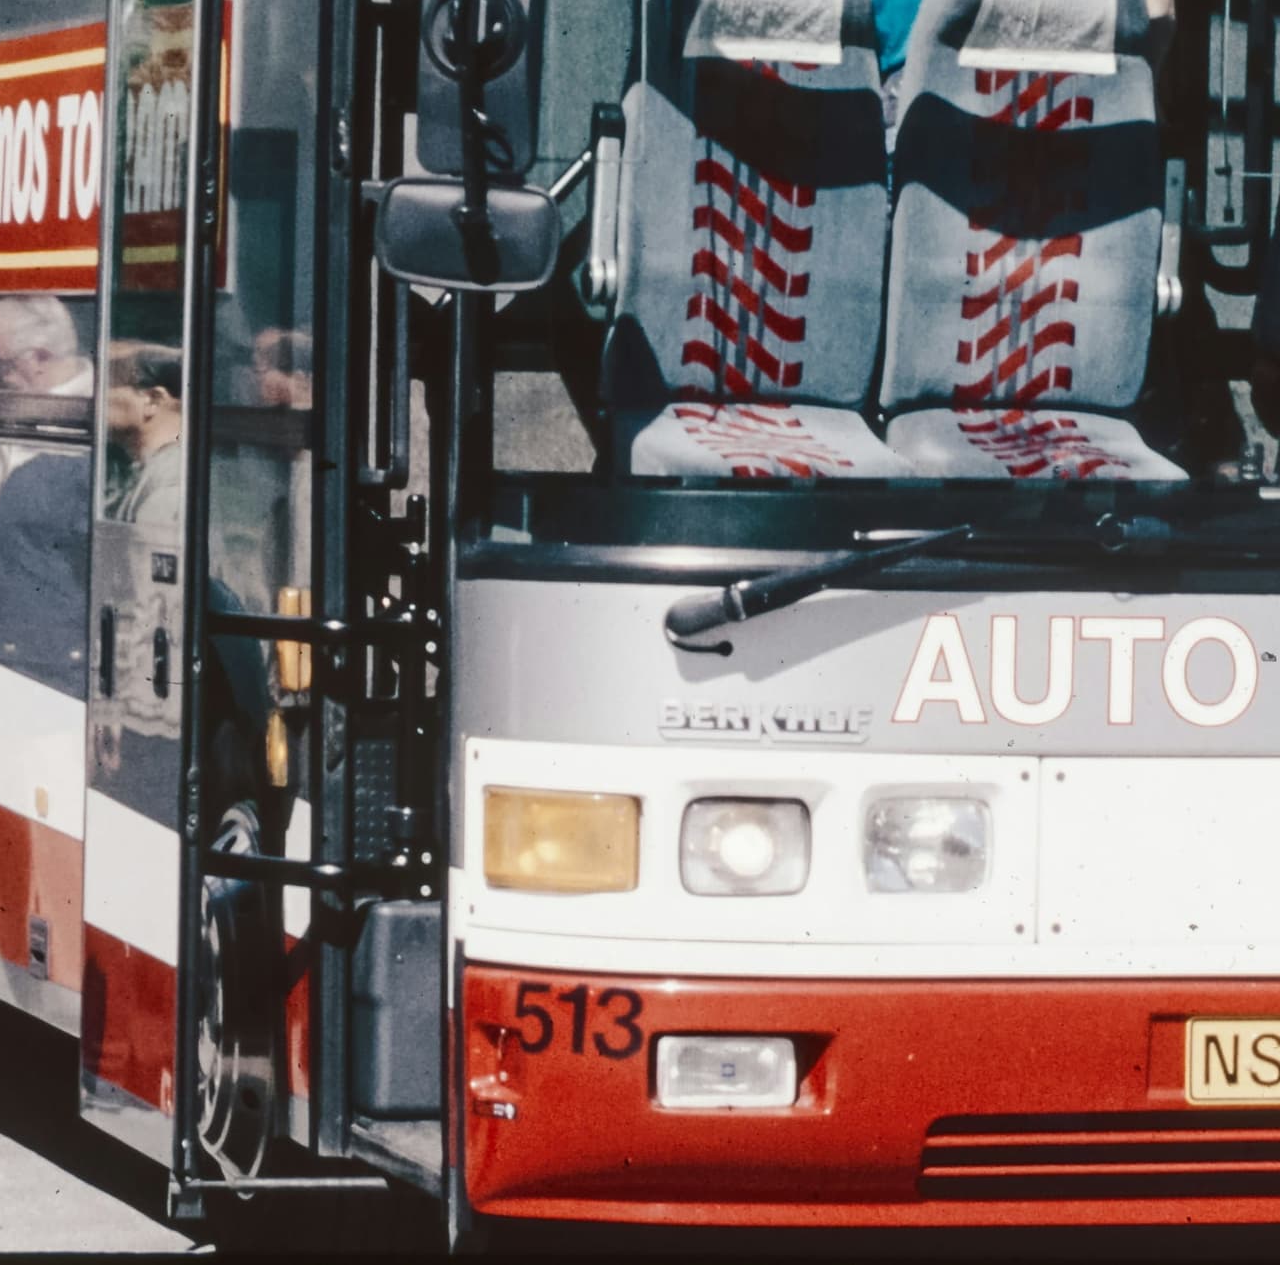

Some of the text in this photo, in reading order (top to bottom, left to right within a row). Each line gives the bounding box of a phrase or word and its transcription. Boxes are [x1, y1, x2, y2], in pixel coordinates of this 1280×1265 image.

[891, 614, 1259, 727] AUTO
[657, 698, 873, 741] BERKHOF
[514, 983, 644, 1060] 513
